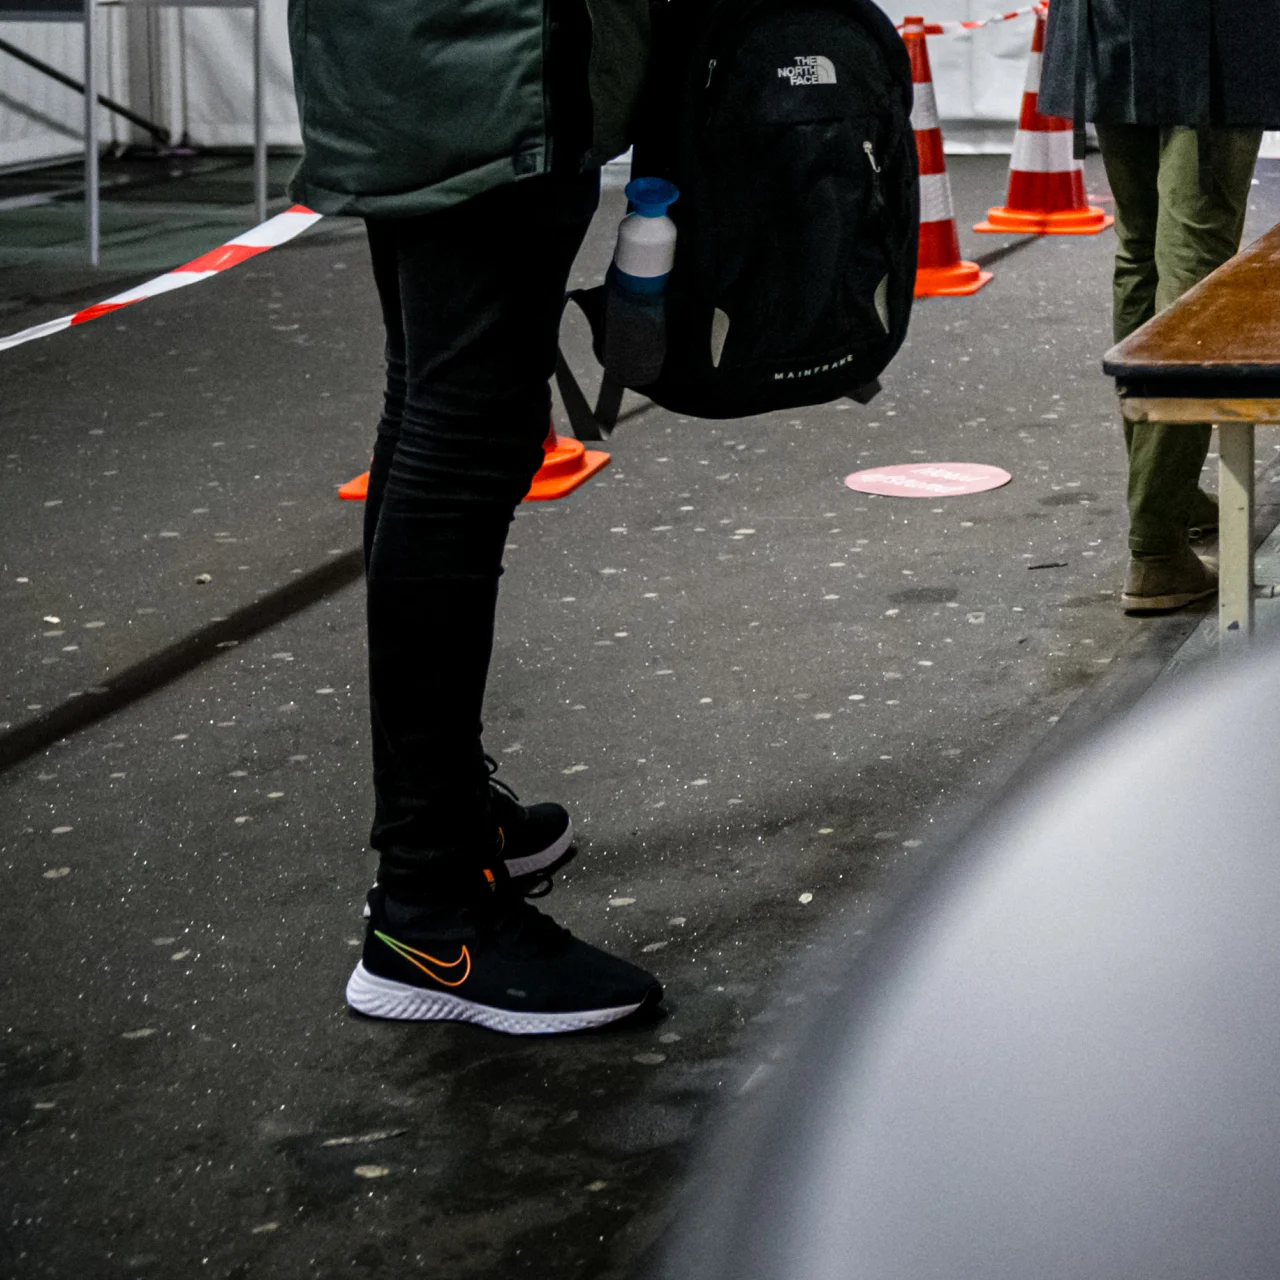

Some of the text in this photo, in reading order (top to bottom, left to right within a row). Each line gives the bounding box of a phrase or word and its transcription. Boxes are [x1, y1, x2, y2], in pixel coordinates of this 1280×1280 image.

[794, 56, 817, 66] THE
[777, 66, 817, 77] NORTH
[790, 75, 819, 86] FACE
